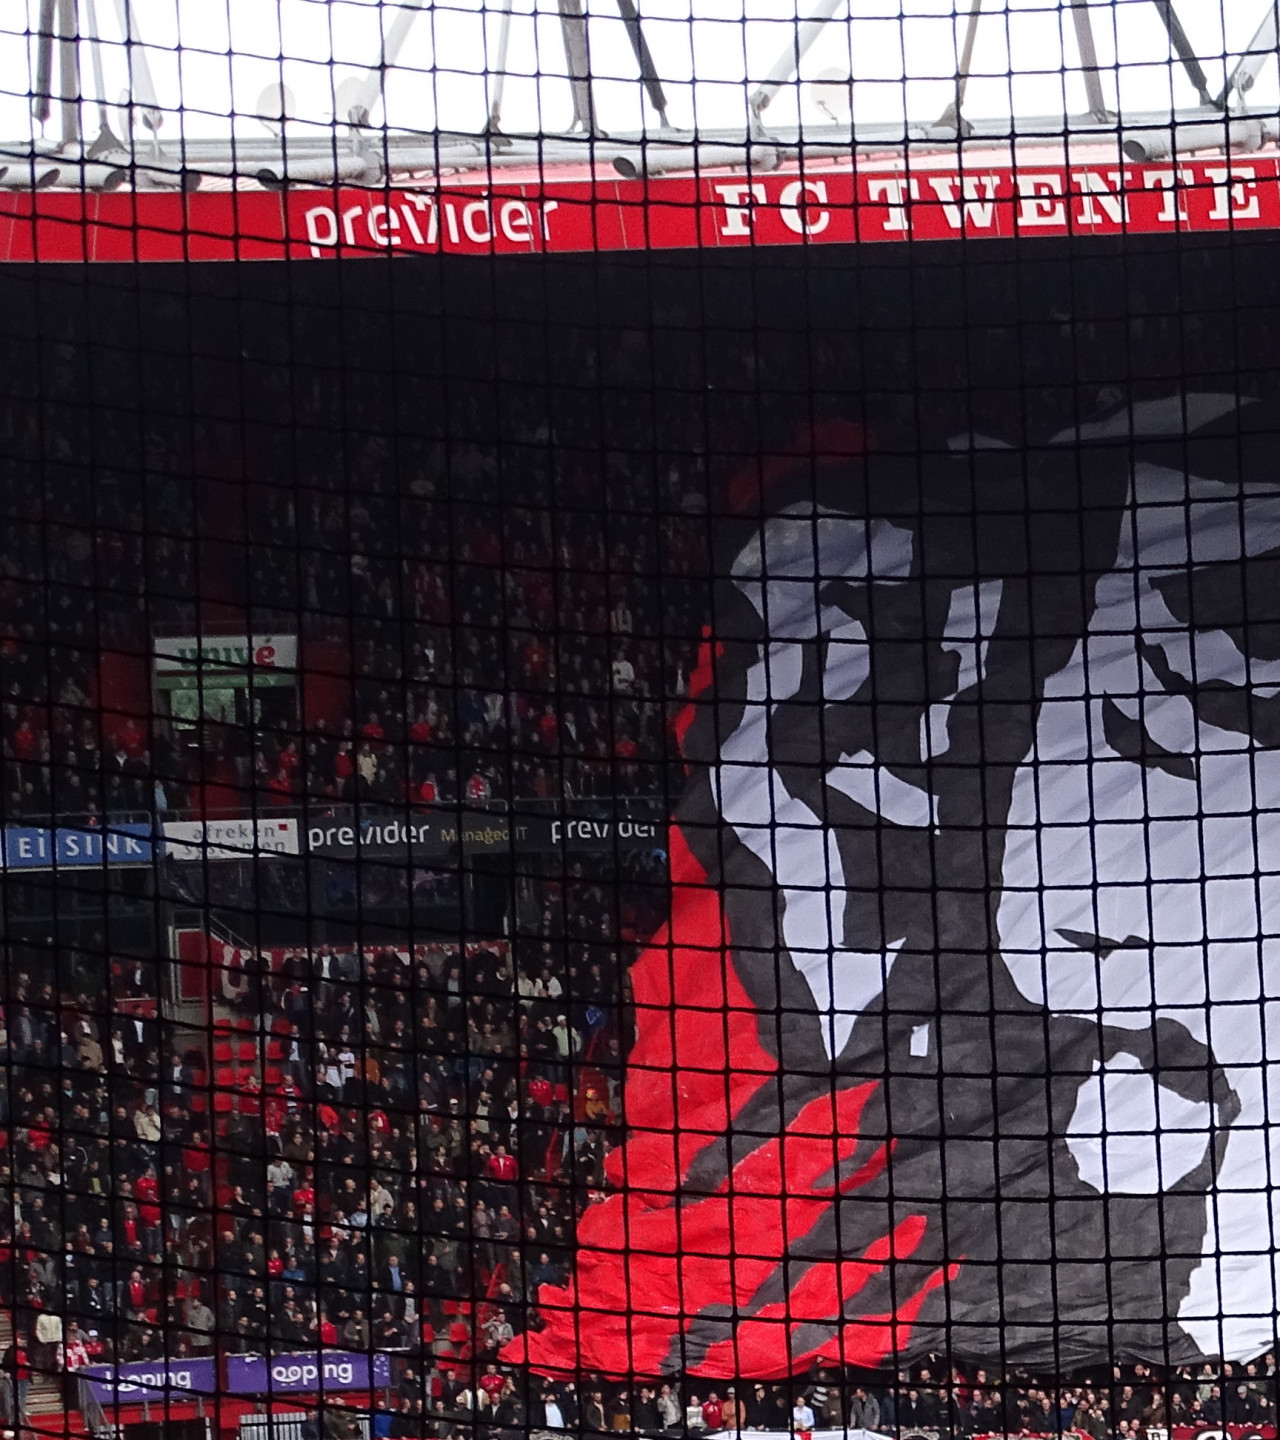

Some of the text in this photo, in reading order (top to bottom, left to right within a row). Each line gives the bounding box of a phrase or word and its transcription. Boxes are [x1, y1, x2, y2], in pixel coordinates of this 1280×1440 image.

[715, 166, 1260, 236] FC TWENTE
[305, 190, 558, 258] previder
[308, 820, 430, 851] previder
[551, 814, 656, 844] prevder
[268, 1360, 353, 1384] oopng
